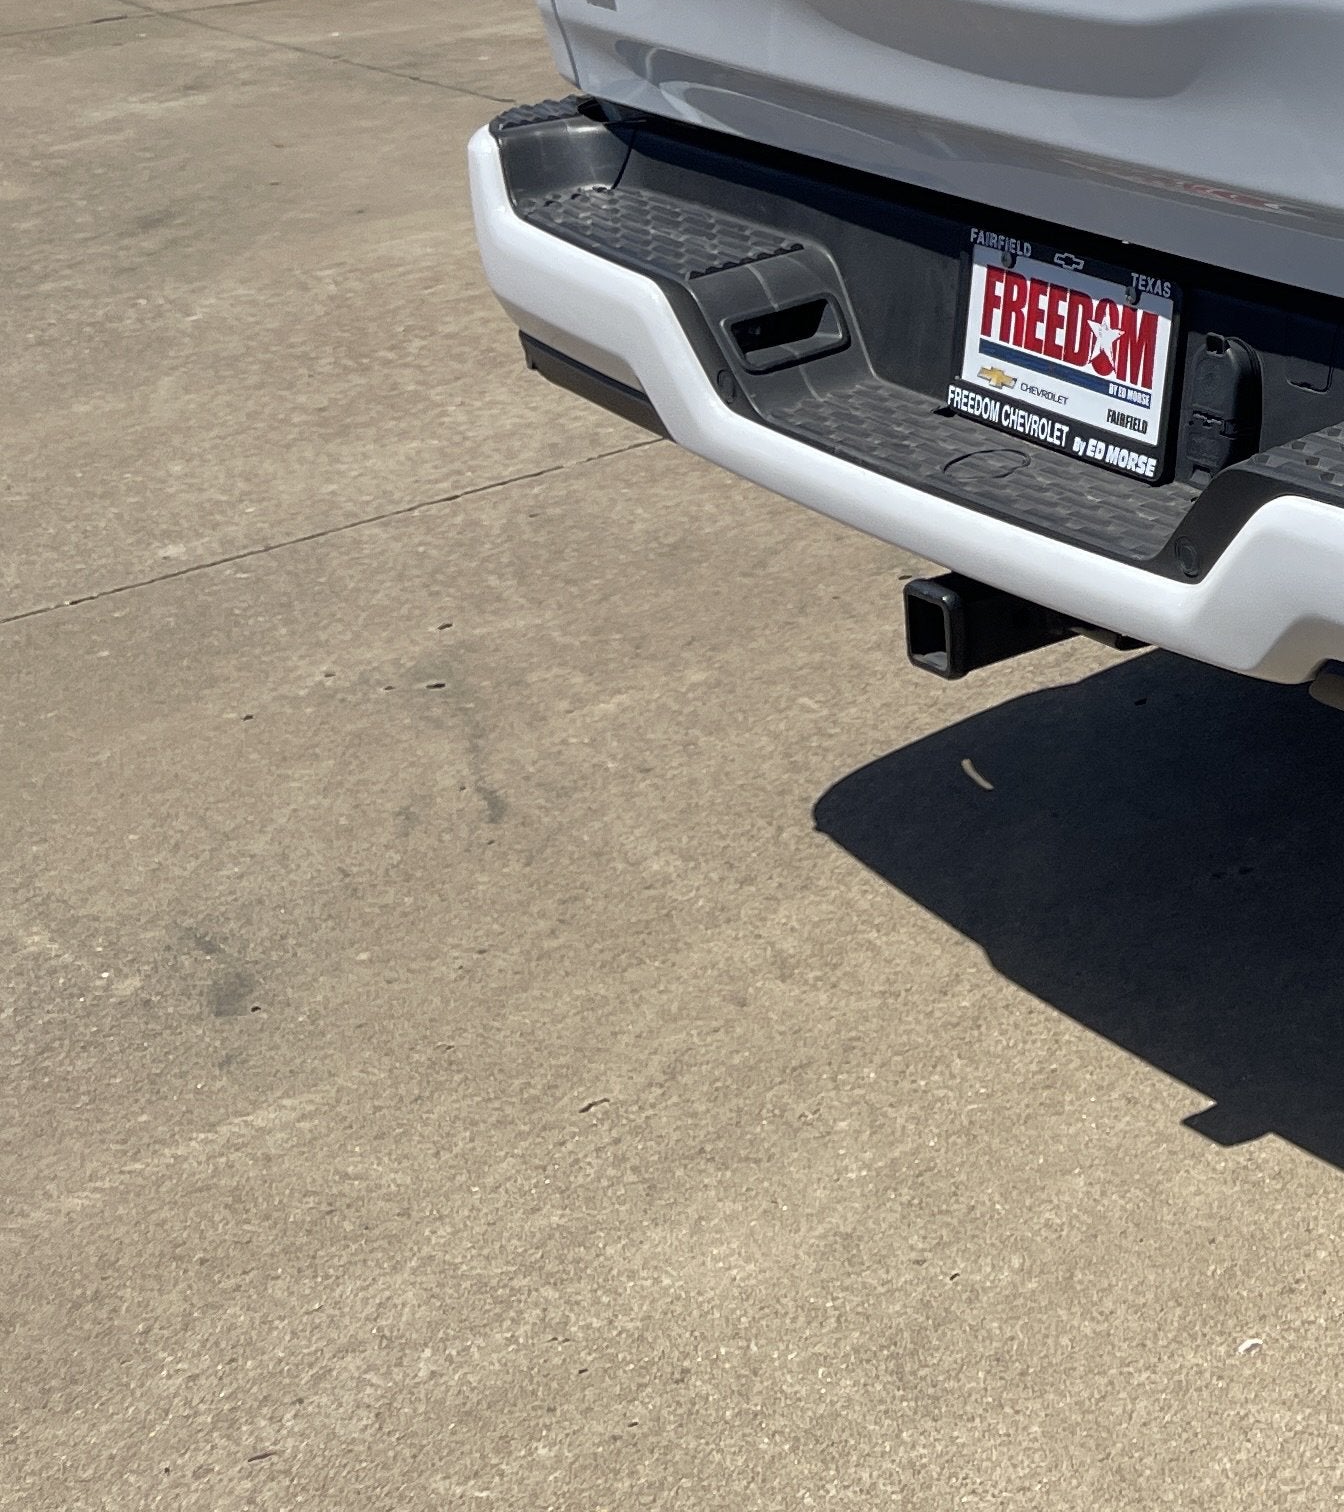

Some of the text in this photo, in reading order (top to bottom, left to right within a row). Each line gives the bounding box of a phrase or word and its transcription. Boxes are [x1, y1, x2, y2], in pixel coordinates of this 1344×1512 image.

[970, 227, 1032, 257] FAIRFIELD
[1131, 273, 1171, 299] TEXAS
[1019, 382, 1069, 405] CHEVROLET
[1108, 382, 1151, 406] BY ED MORSE
[947, 385, 1000, 422] FREEDOM
[1001, 404, 1070, 448] CHEVROLET
[1088, 436, 1104, 459] ED
[1105, 442, 1157, 478] MORSE
[1106, 408, 1148, 434] FAIRFIELD
